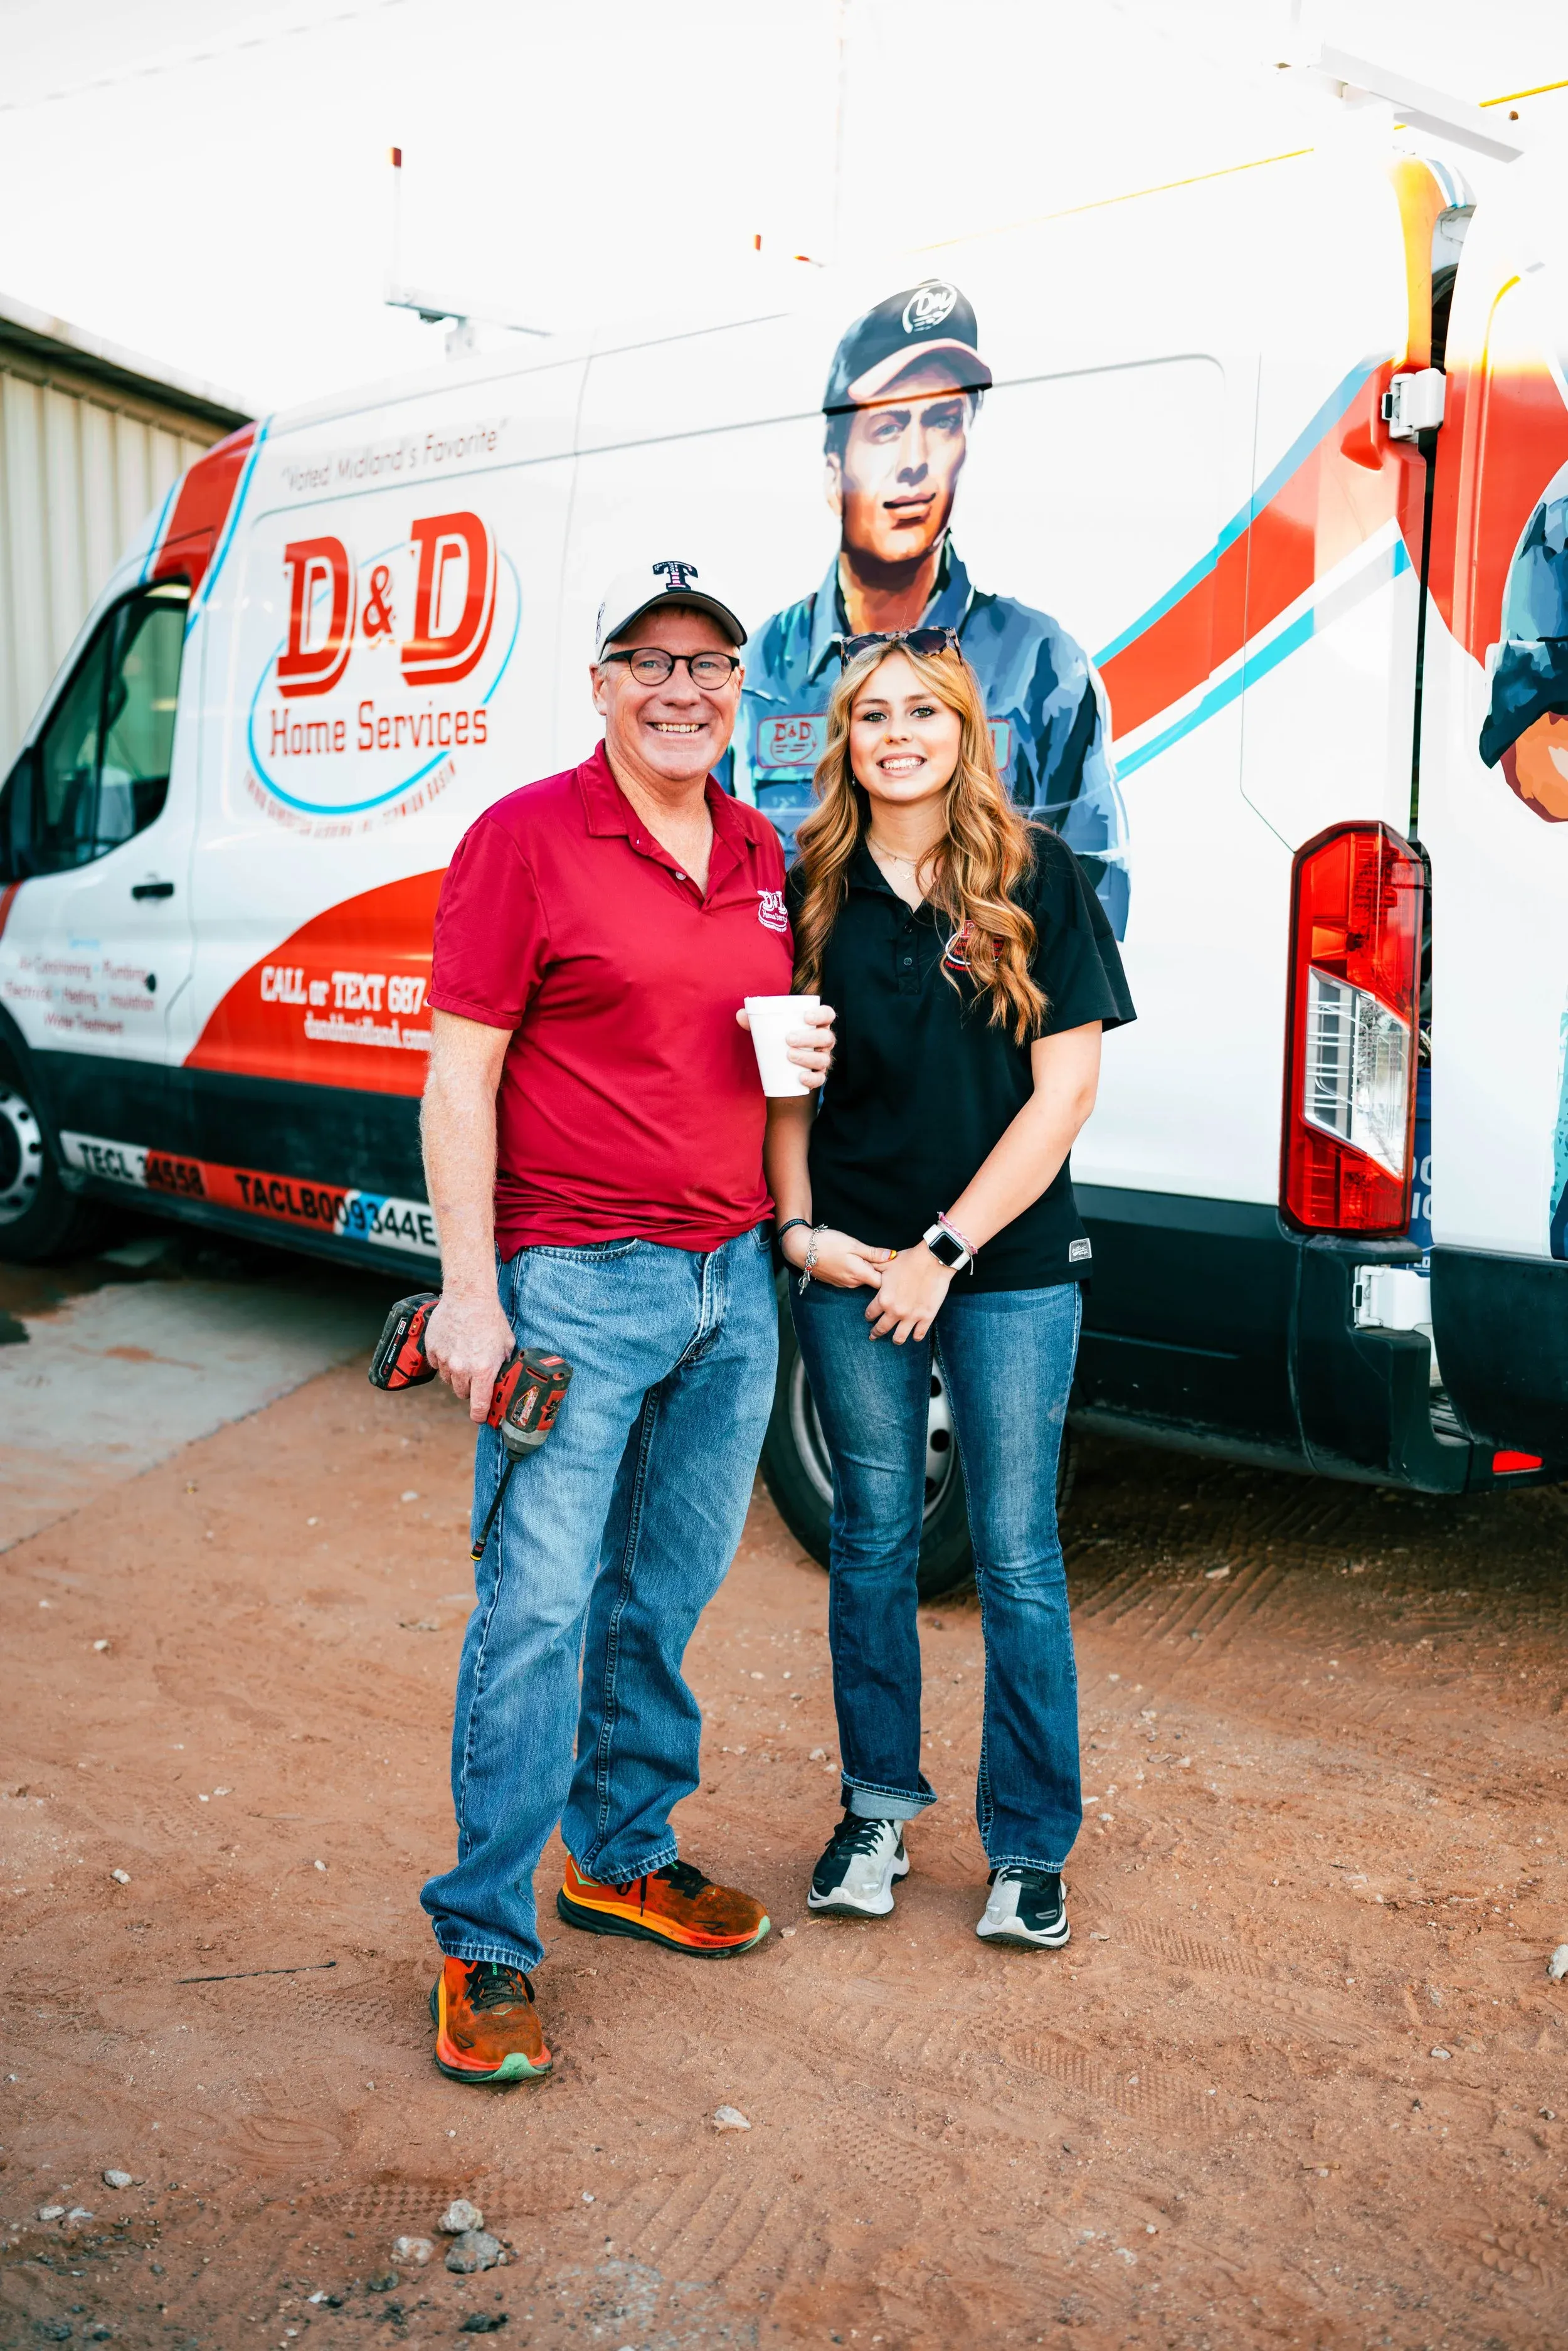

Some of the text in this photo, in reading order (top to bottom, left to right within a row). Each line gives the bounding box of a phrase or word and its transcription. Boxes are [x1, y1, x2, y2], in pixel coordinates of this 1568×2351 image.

[652, 561, 698, 591] T
[269, 701, 487, 756] Home Services
[260, 965, 307, 1005] CALL
[309, 980, 330, 1006] or
[331, 970, 386, 1012] TEXT
[78, 1142, 135, 1181] TECL
